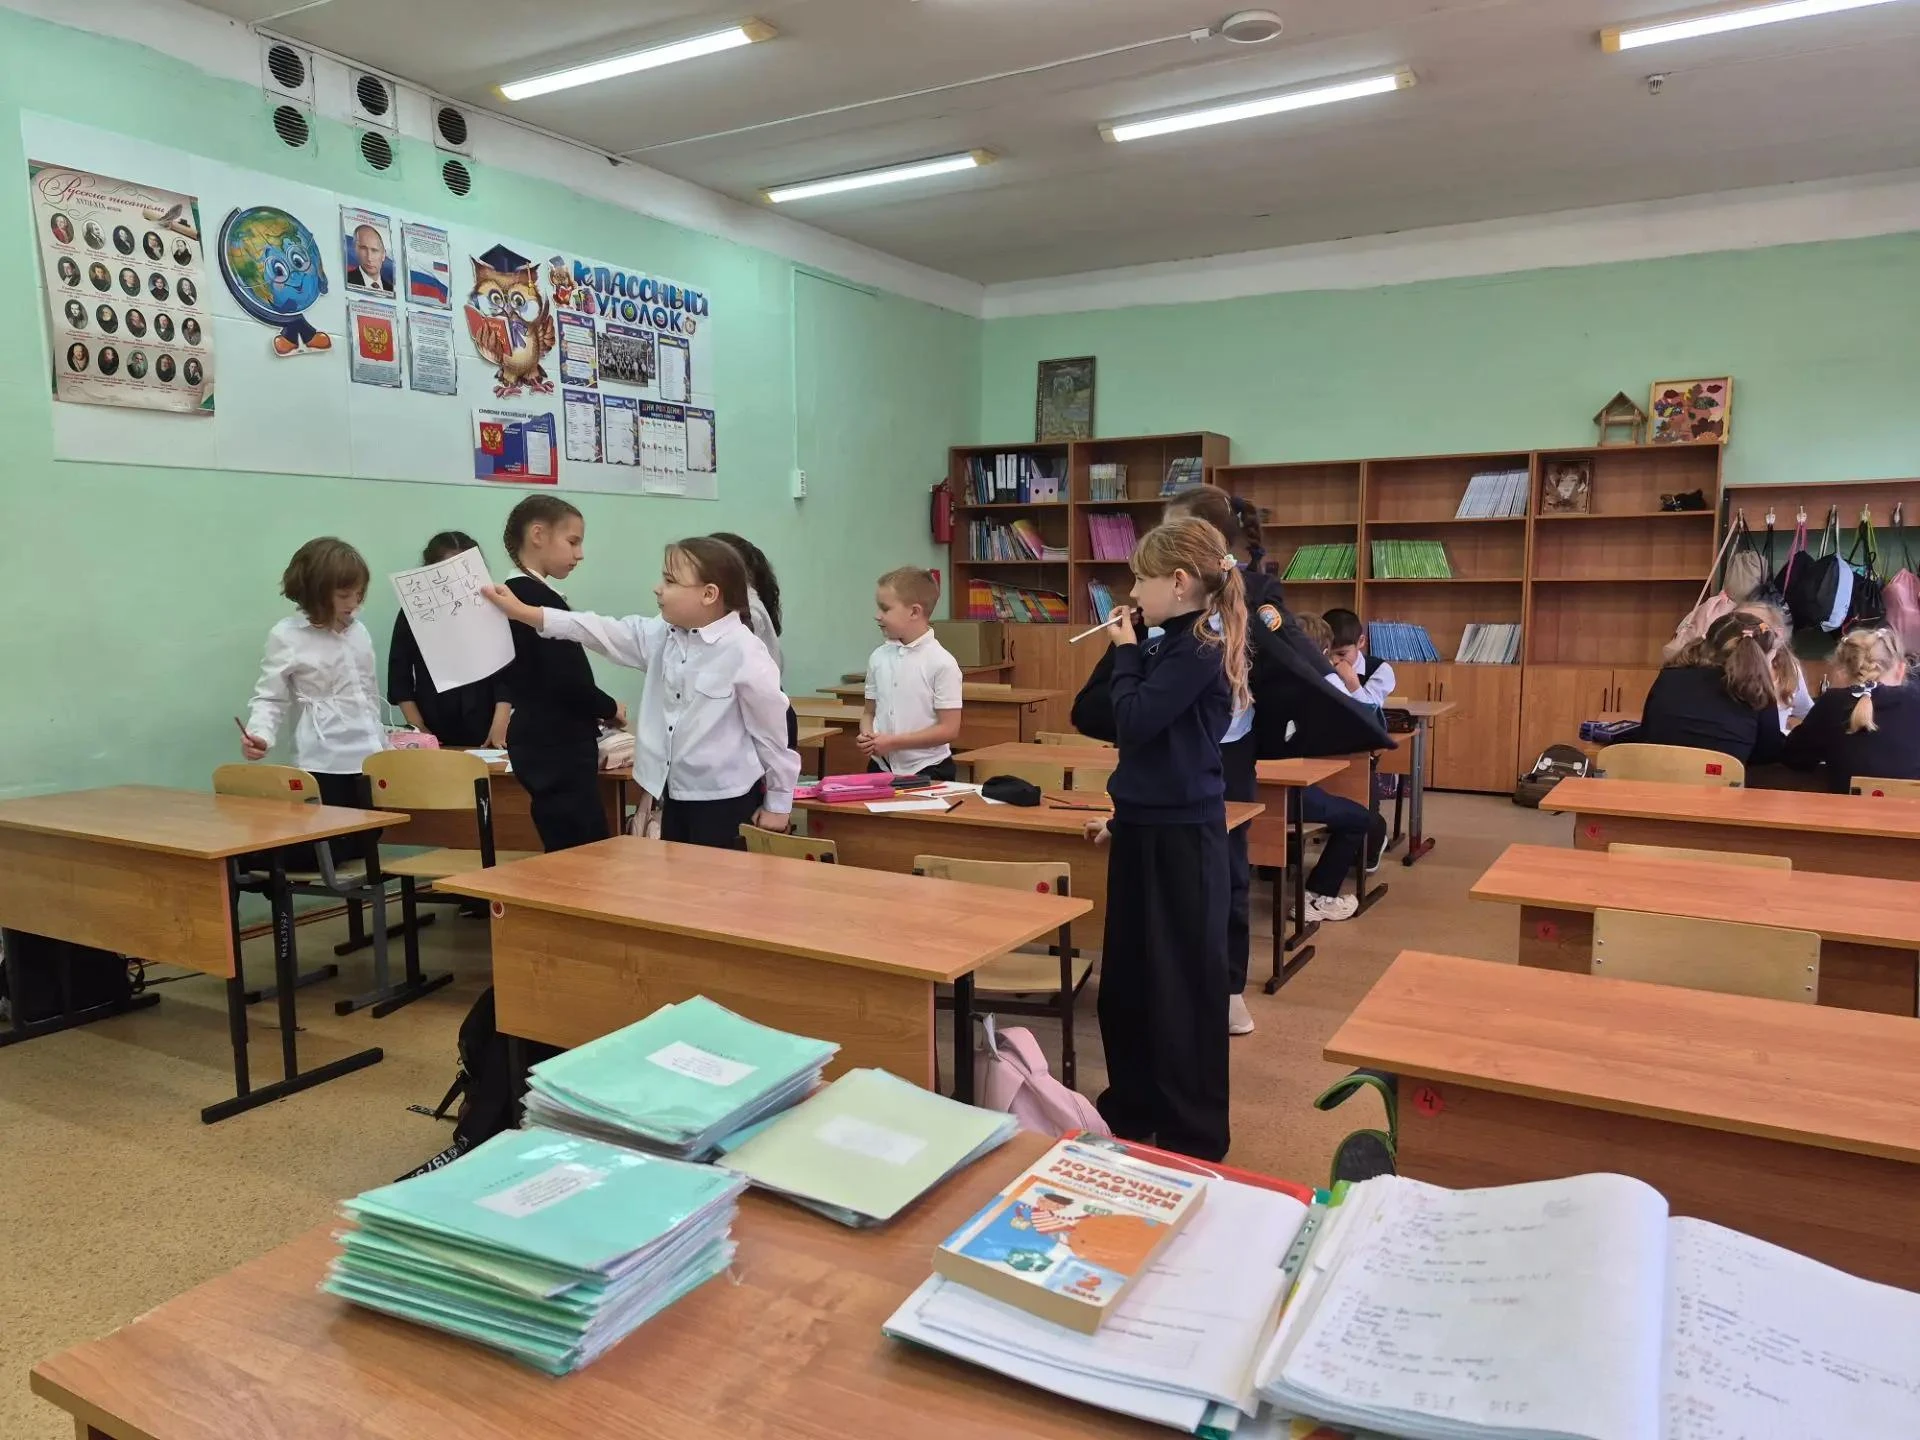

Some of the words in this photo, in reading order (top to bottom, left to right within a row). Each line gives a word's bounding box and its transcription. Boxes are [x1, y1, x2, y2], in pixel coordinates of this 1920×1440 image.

[595, 292, 682, 333] УГОЛОК
[1423, 1089, 1434, 1110] 4
[1048, 1165, 1176, 1211] РАЗРАБОТКИ
[1057, 1158, 1183, 1203] ПОУРОЧНЫЕ
[1076, 1272, 1102, 1292] 2
